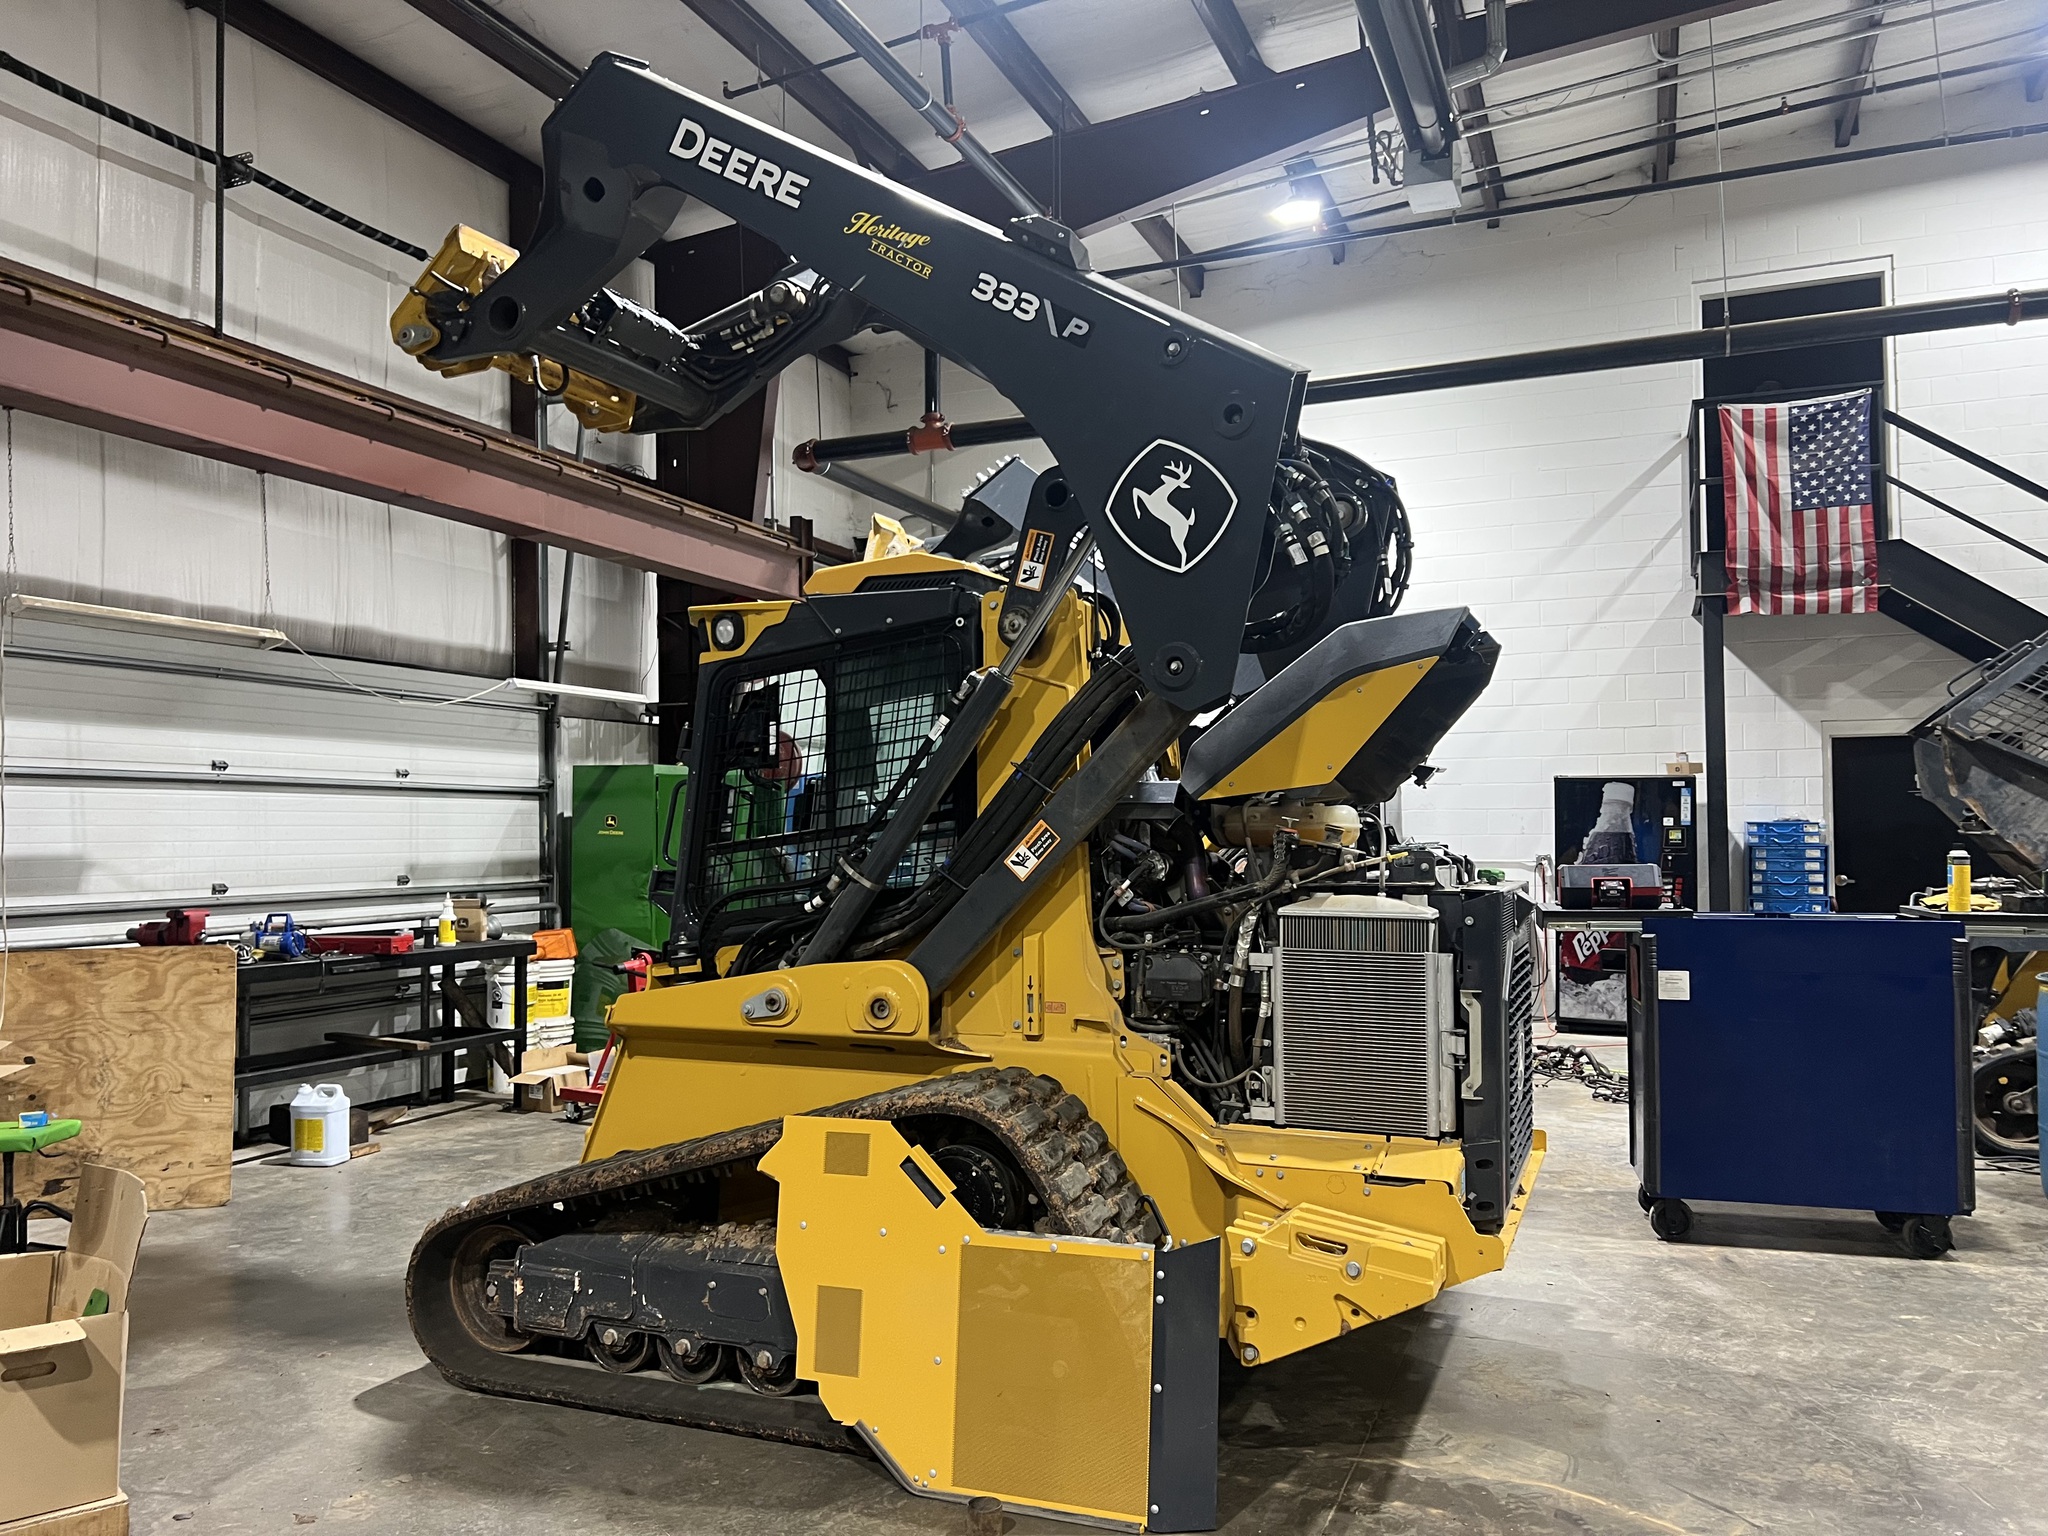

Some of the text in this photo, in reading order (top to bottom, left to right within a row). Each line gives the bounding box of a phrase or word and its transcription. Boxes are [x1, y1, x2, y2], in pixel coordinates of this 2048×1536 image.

[668, 117, 810, 209] DEERE
[843, 211, 931, 249] Heritage
[870, 240, 932, 277] TRACTOR
